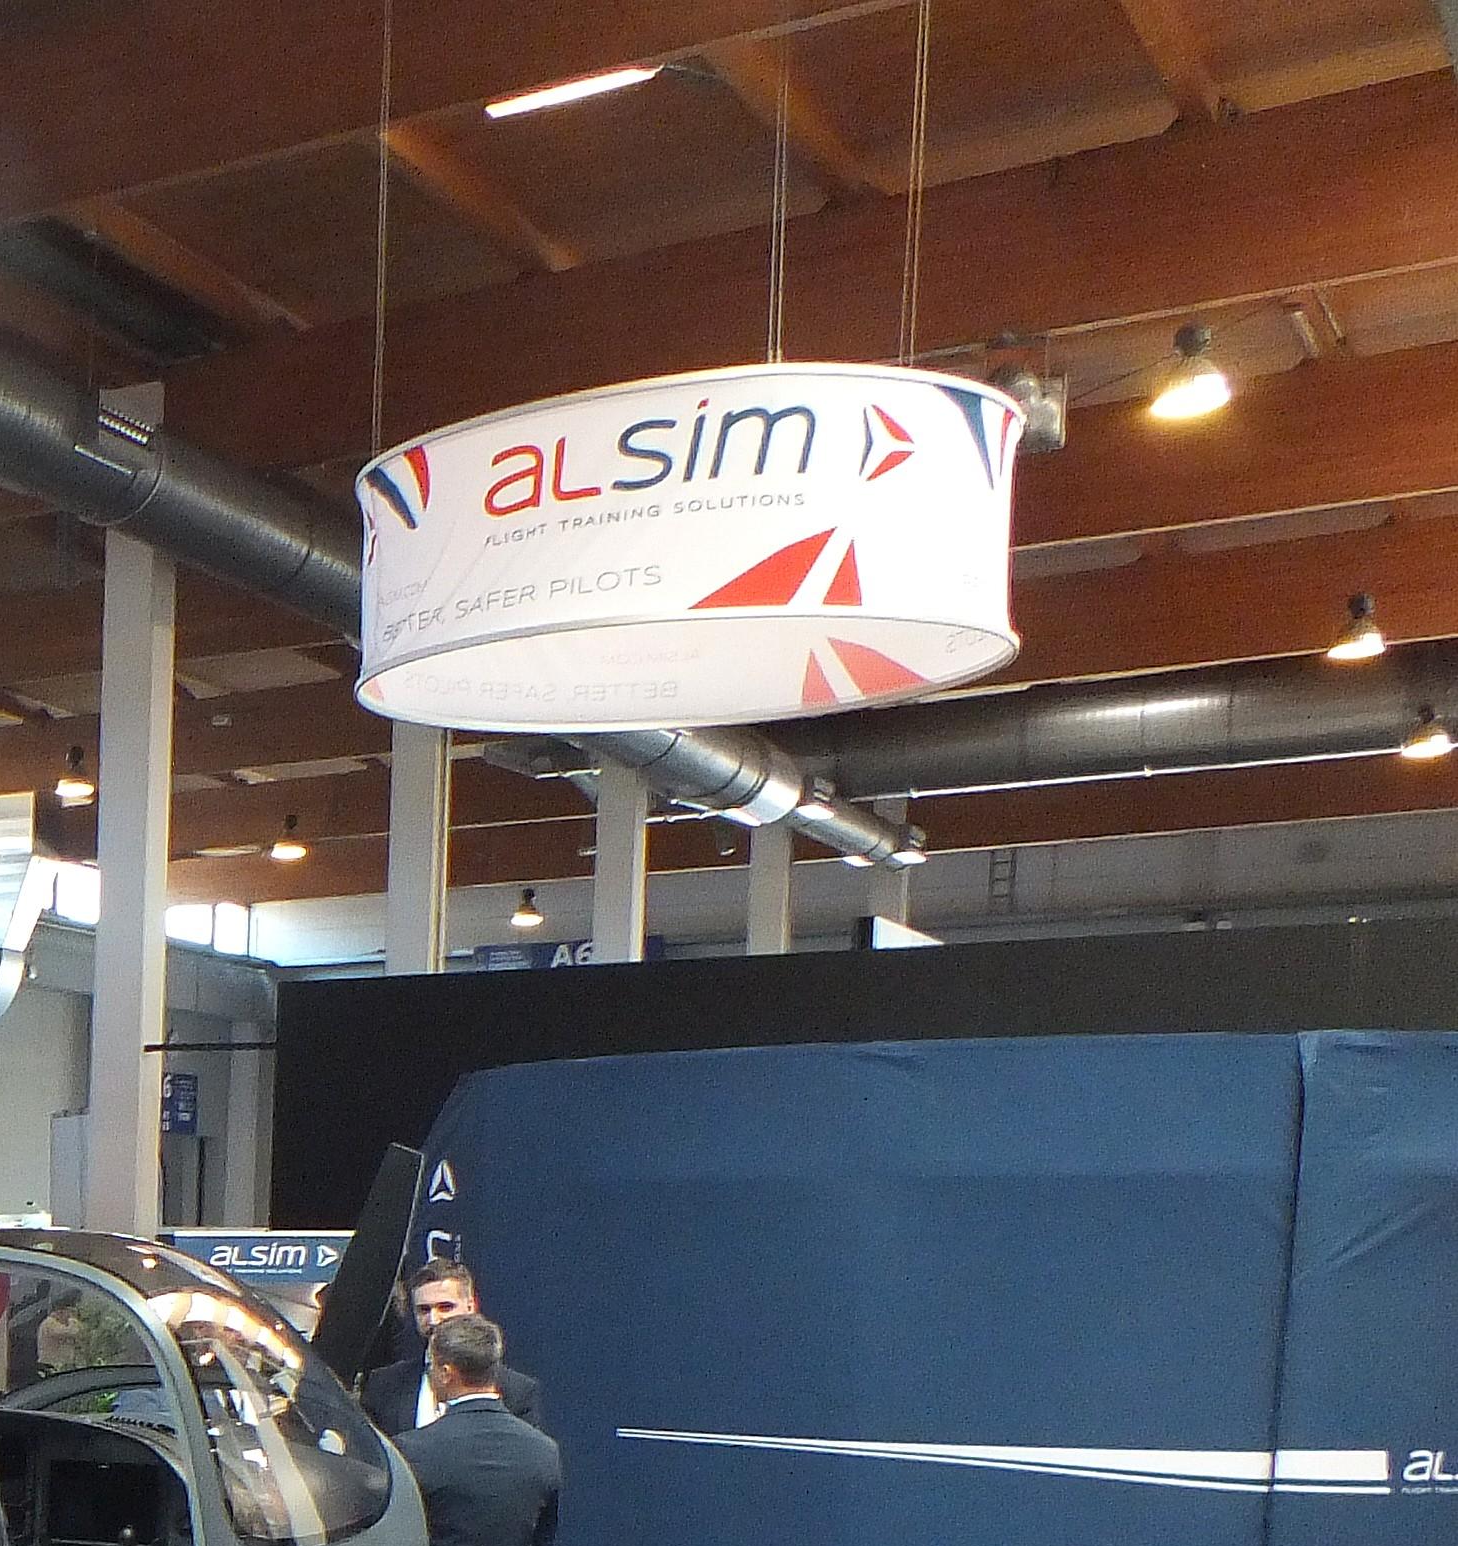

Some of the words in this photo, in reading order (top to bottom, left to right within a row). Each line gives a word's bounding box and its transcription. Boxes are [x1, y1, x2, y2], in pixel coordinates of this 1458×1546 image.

[484, 523, 548, 548] FLIGHT
[557, 504, 663, 532] TRAINING
[673, 493, 806, 513] SOLUTIONS
[455, 584, 536, 620] SAFER
[549, 565, 663, 599] PILOTS
